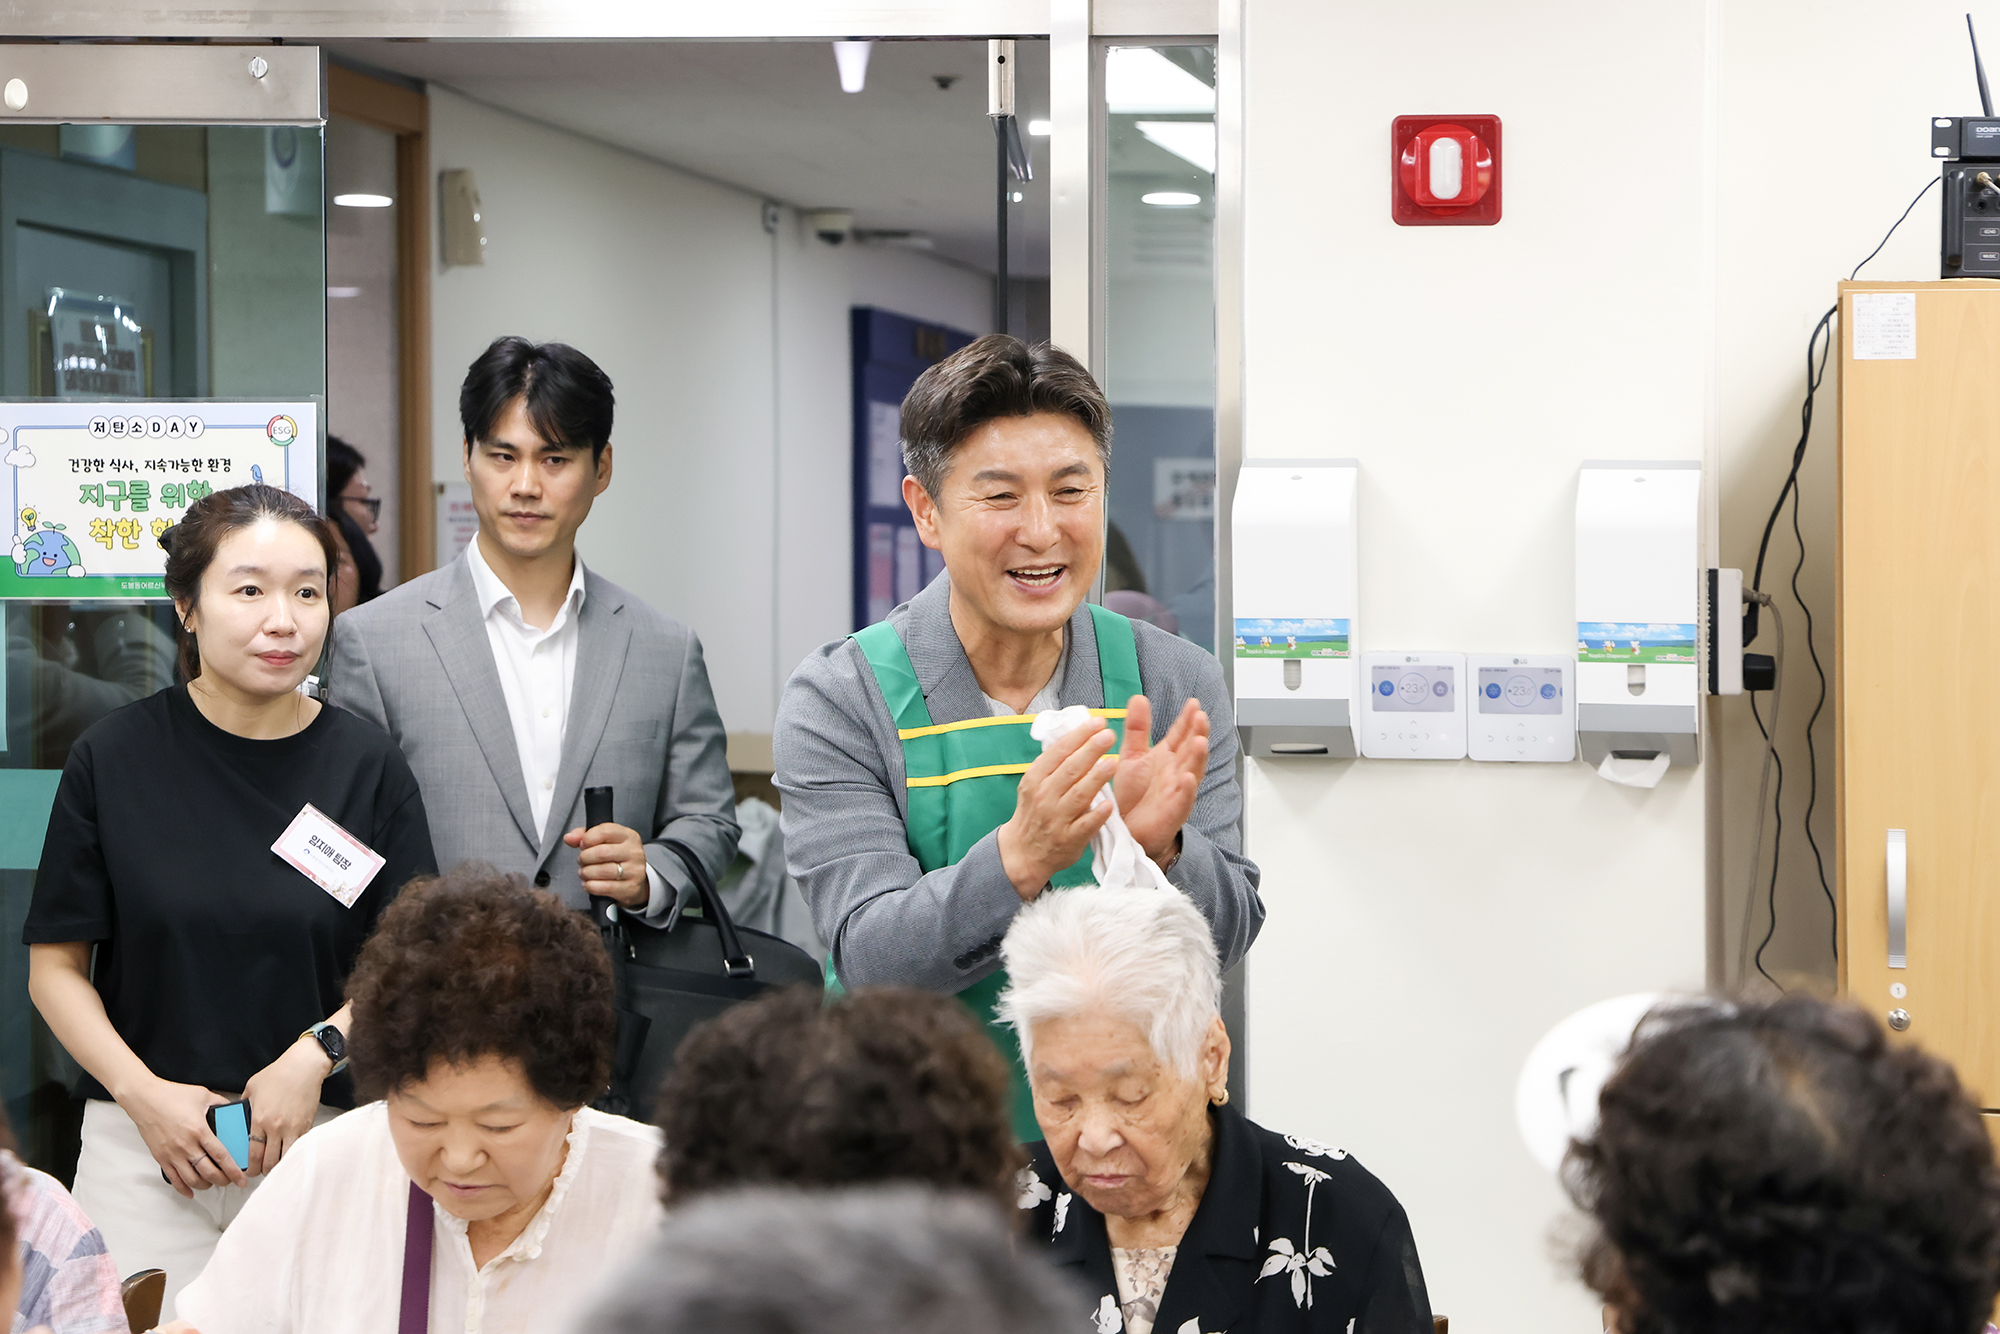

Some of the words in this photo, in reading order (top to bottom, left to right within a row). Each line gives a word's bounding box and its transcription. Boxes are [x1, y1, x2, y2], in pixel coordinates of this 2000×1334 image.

[272, 425, 292, 435] ESG
[68, 458, 105, 473] 건강한
[109, 459, 139, 473] 식사,
[144, 458, 203, 473] 지속가능한
[207, 458, 232, 473] 환경
[78, 479, 152, 512] 지구를
[88, 517, 143, 550] 착한
[308, 834, 336, 859] 임지애
[332, 852, 352, 871] 팀장
